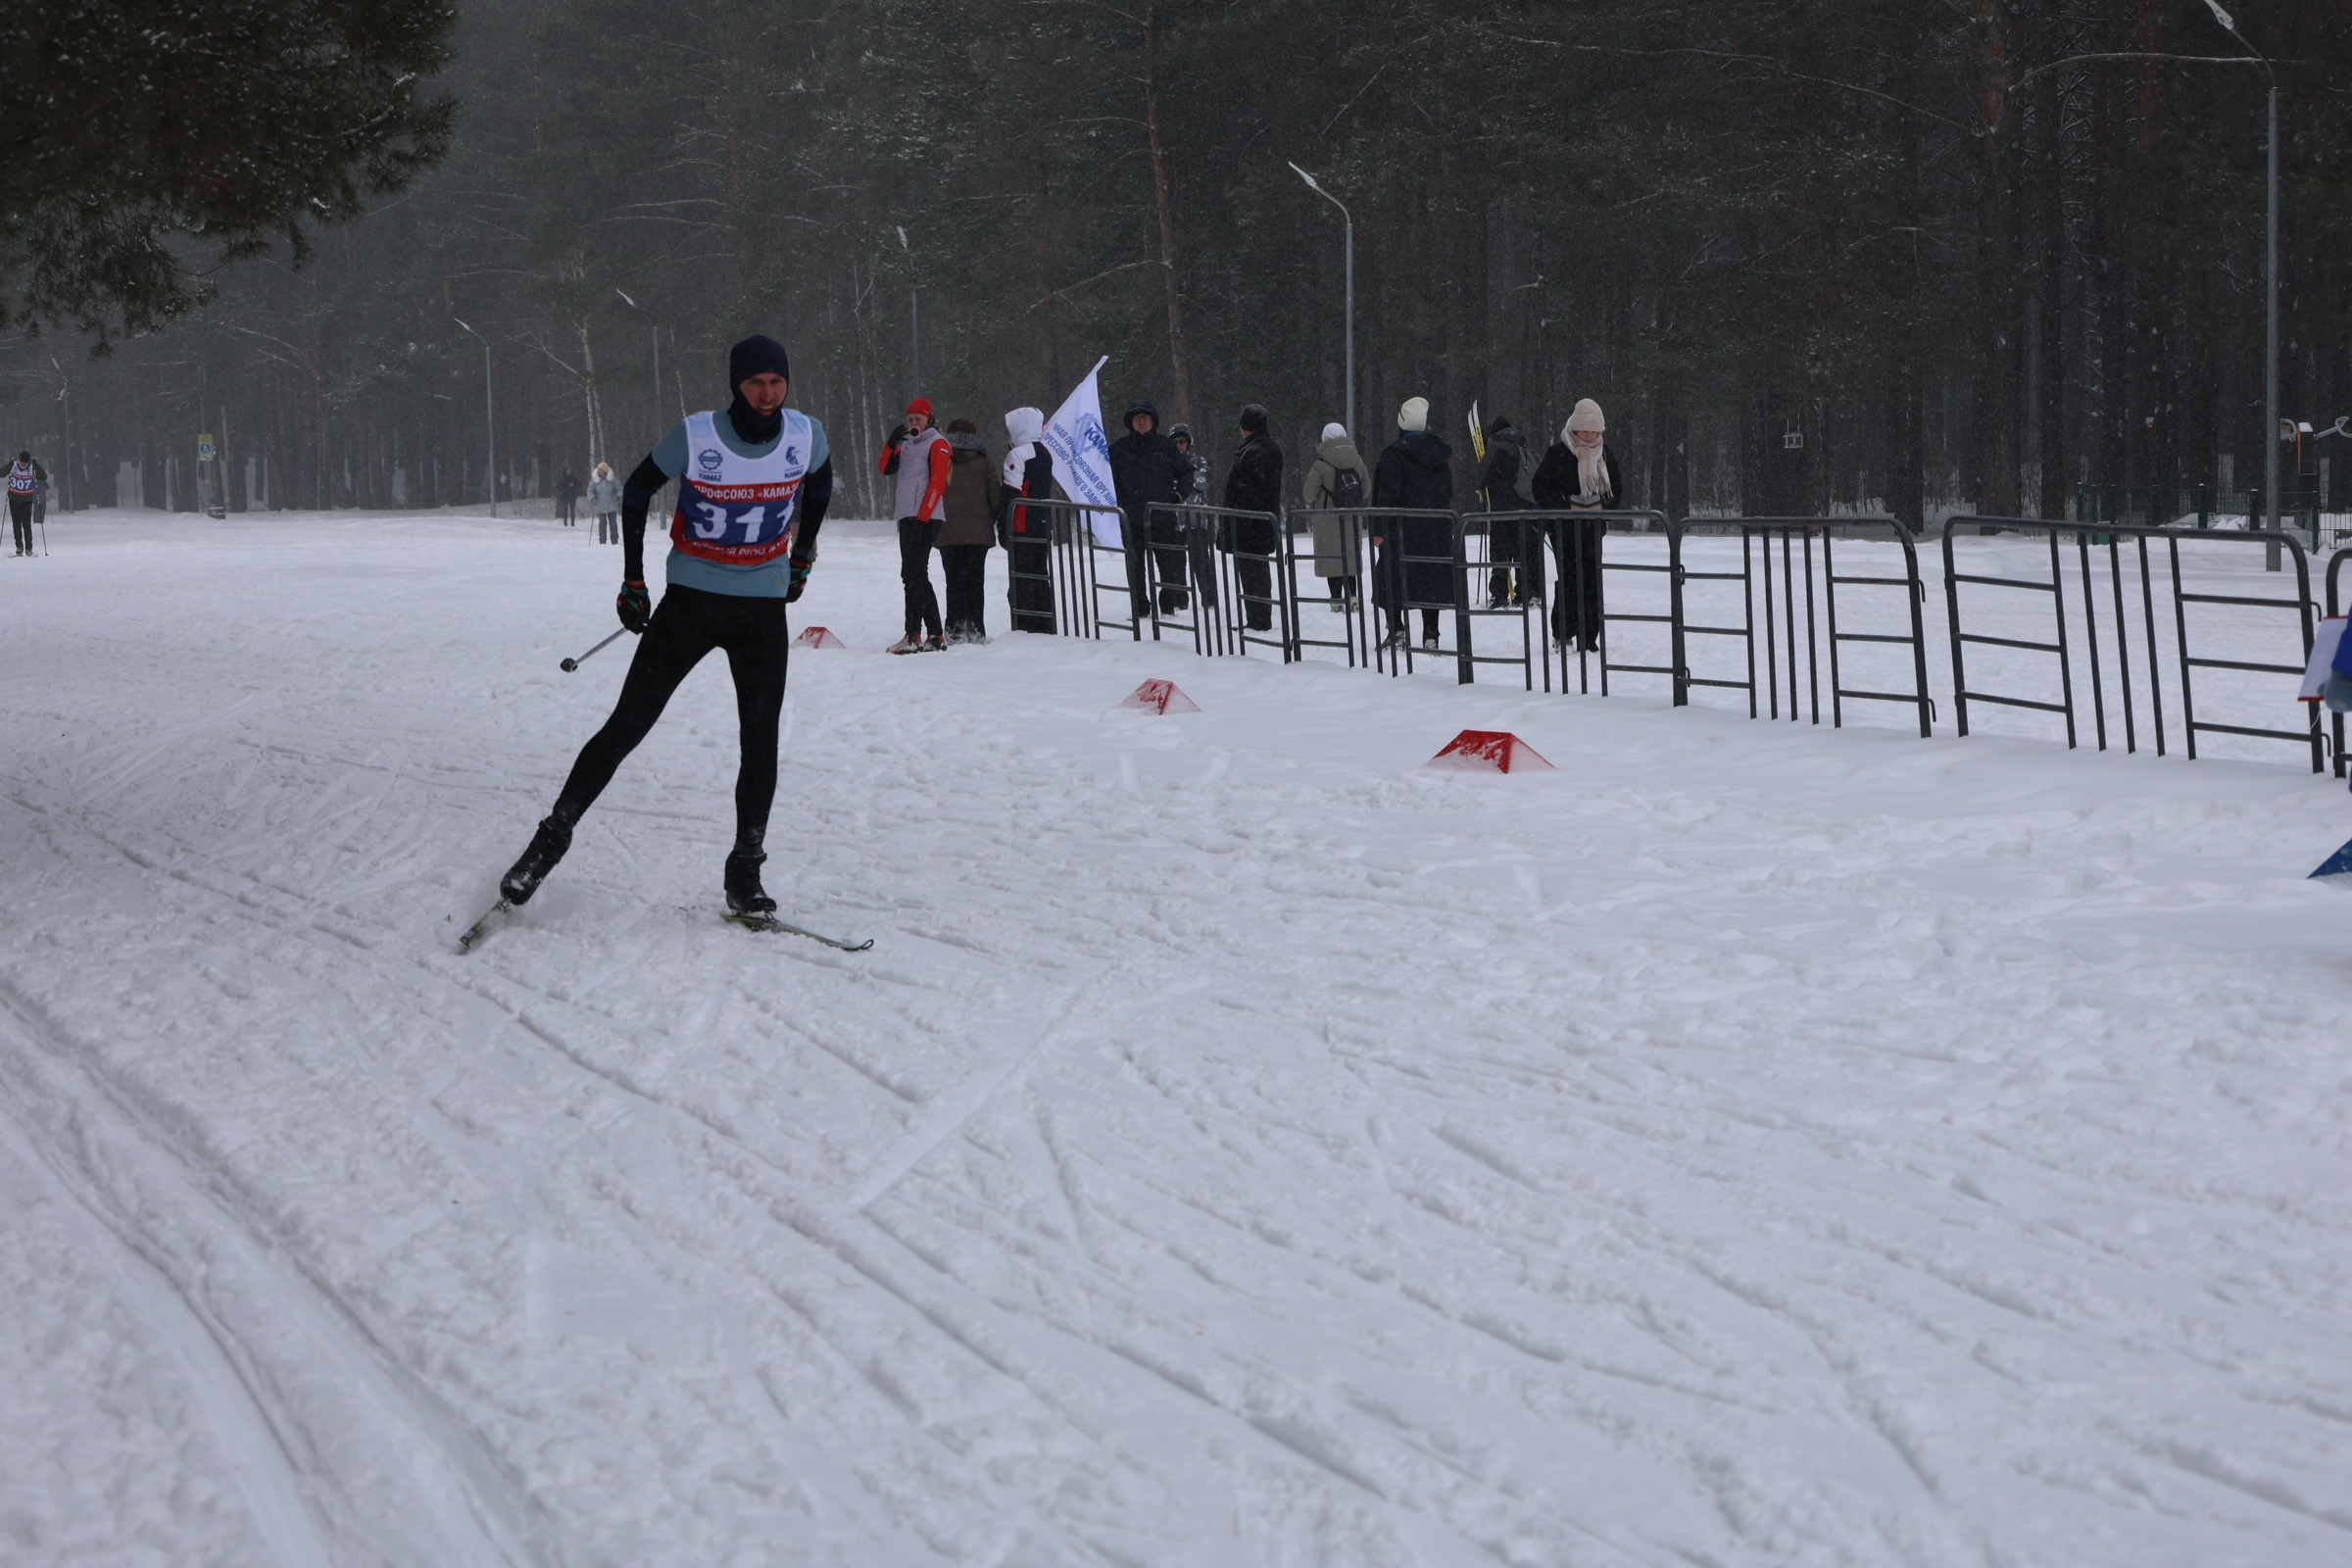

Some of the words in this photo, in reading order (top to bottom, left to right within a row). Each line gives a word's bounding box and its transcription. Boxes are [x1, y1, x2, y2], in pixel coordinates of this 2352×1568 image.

[1084, 427, 1110, 463] KAMA
[698, 472, 722, 482] KAMAZ
[784, 468, 804, 479] KAMAZ
[10, 477, 31, 490] 307
[695, 485, 755, 500] ПРОФСОЮЗ
[1084, 489, 1104, 516] ЗАВОА
[693, 493, 796, 543] 311
